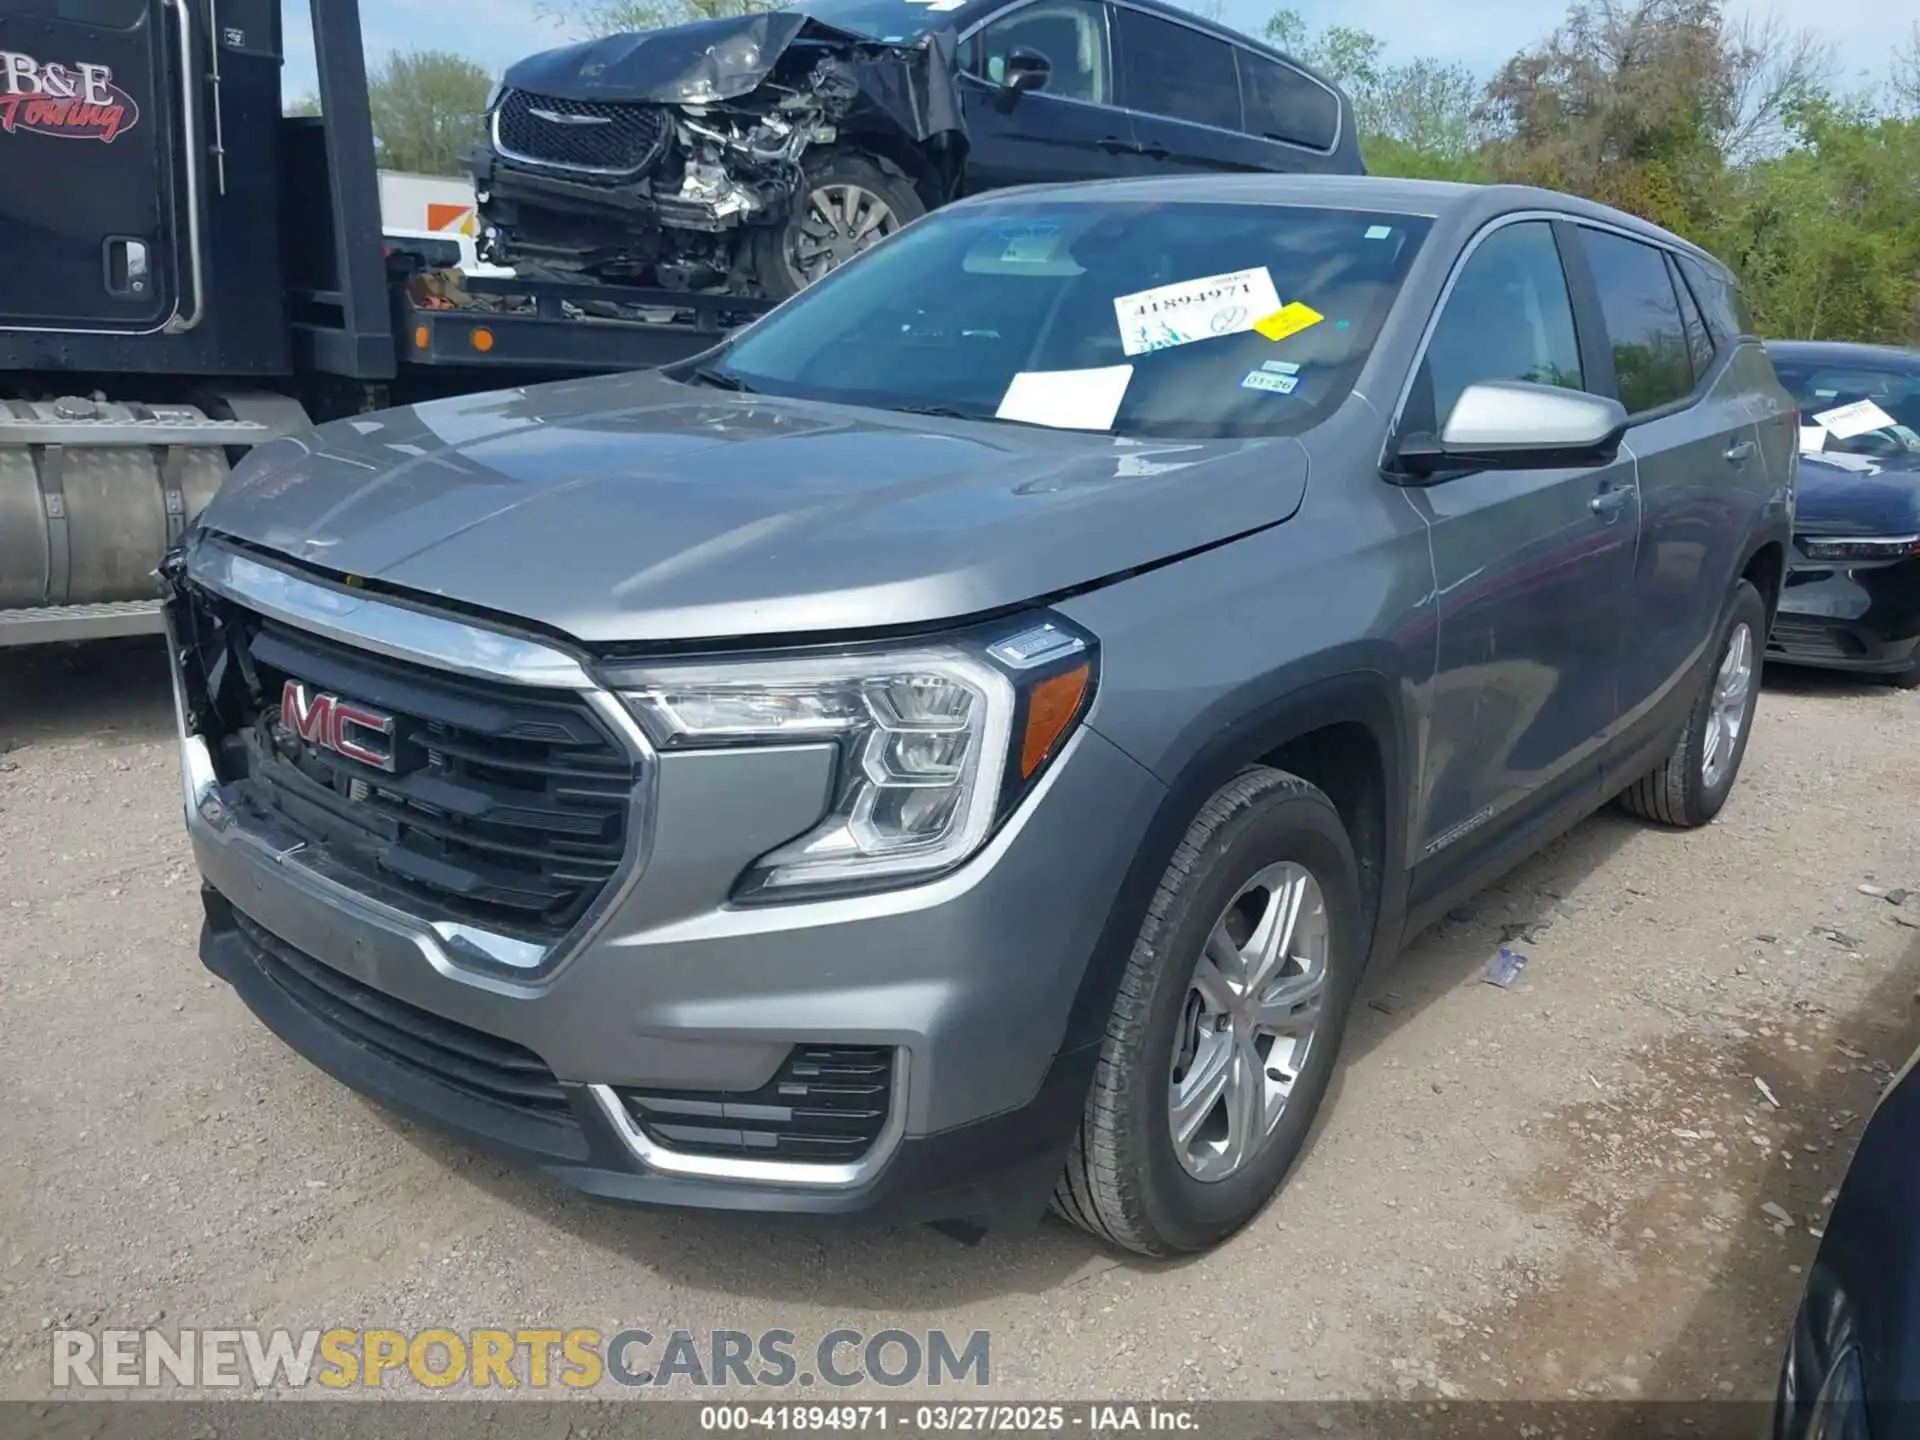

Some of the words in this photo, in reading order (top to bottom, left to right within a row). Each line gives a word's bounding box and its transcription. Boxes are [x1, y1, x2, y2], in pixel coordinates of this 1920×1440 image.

[1, 50, 114, 106] B&E
[0, 91, 124, 138] Towing
[1133, 283, 1251, 316] 41894971
[281, 679, 396, 773] MC
